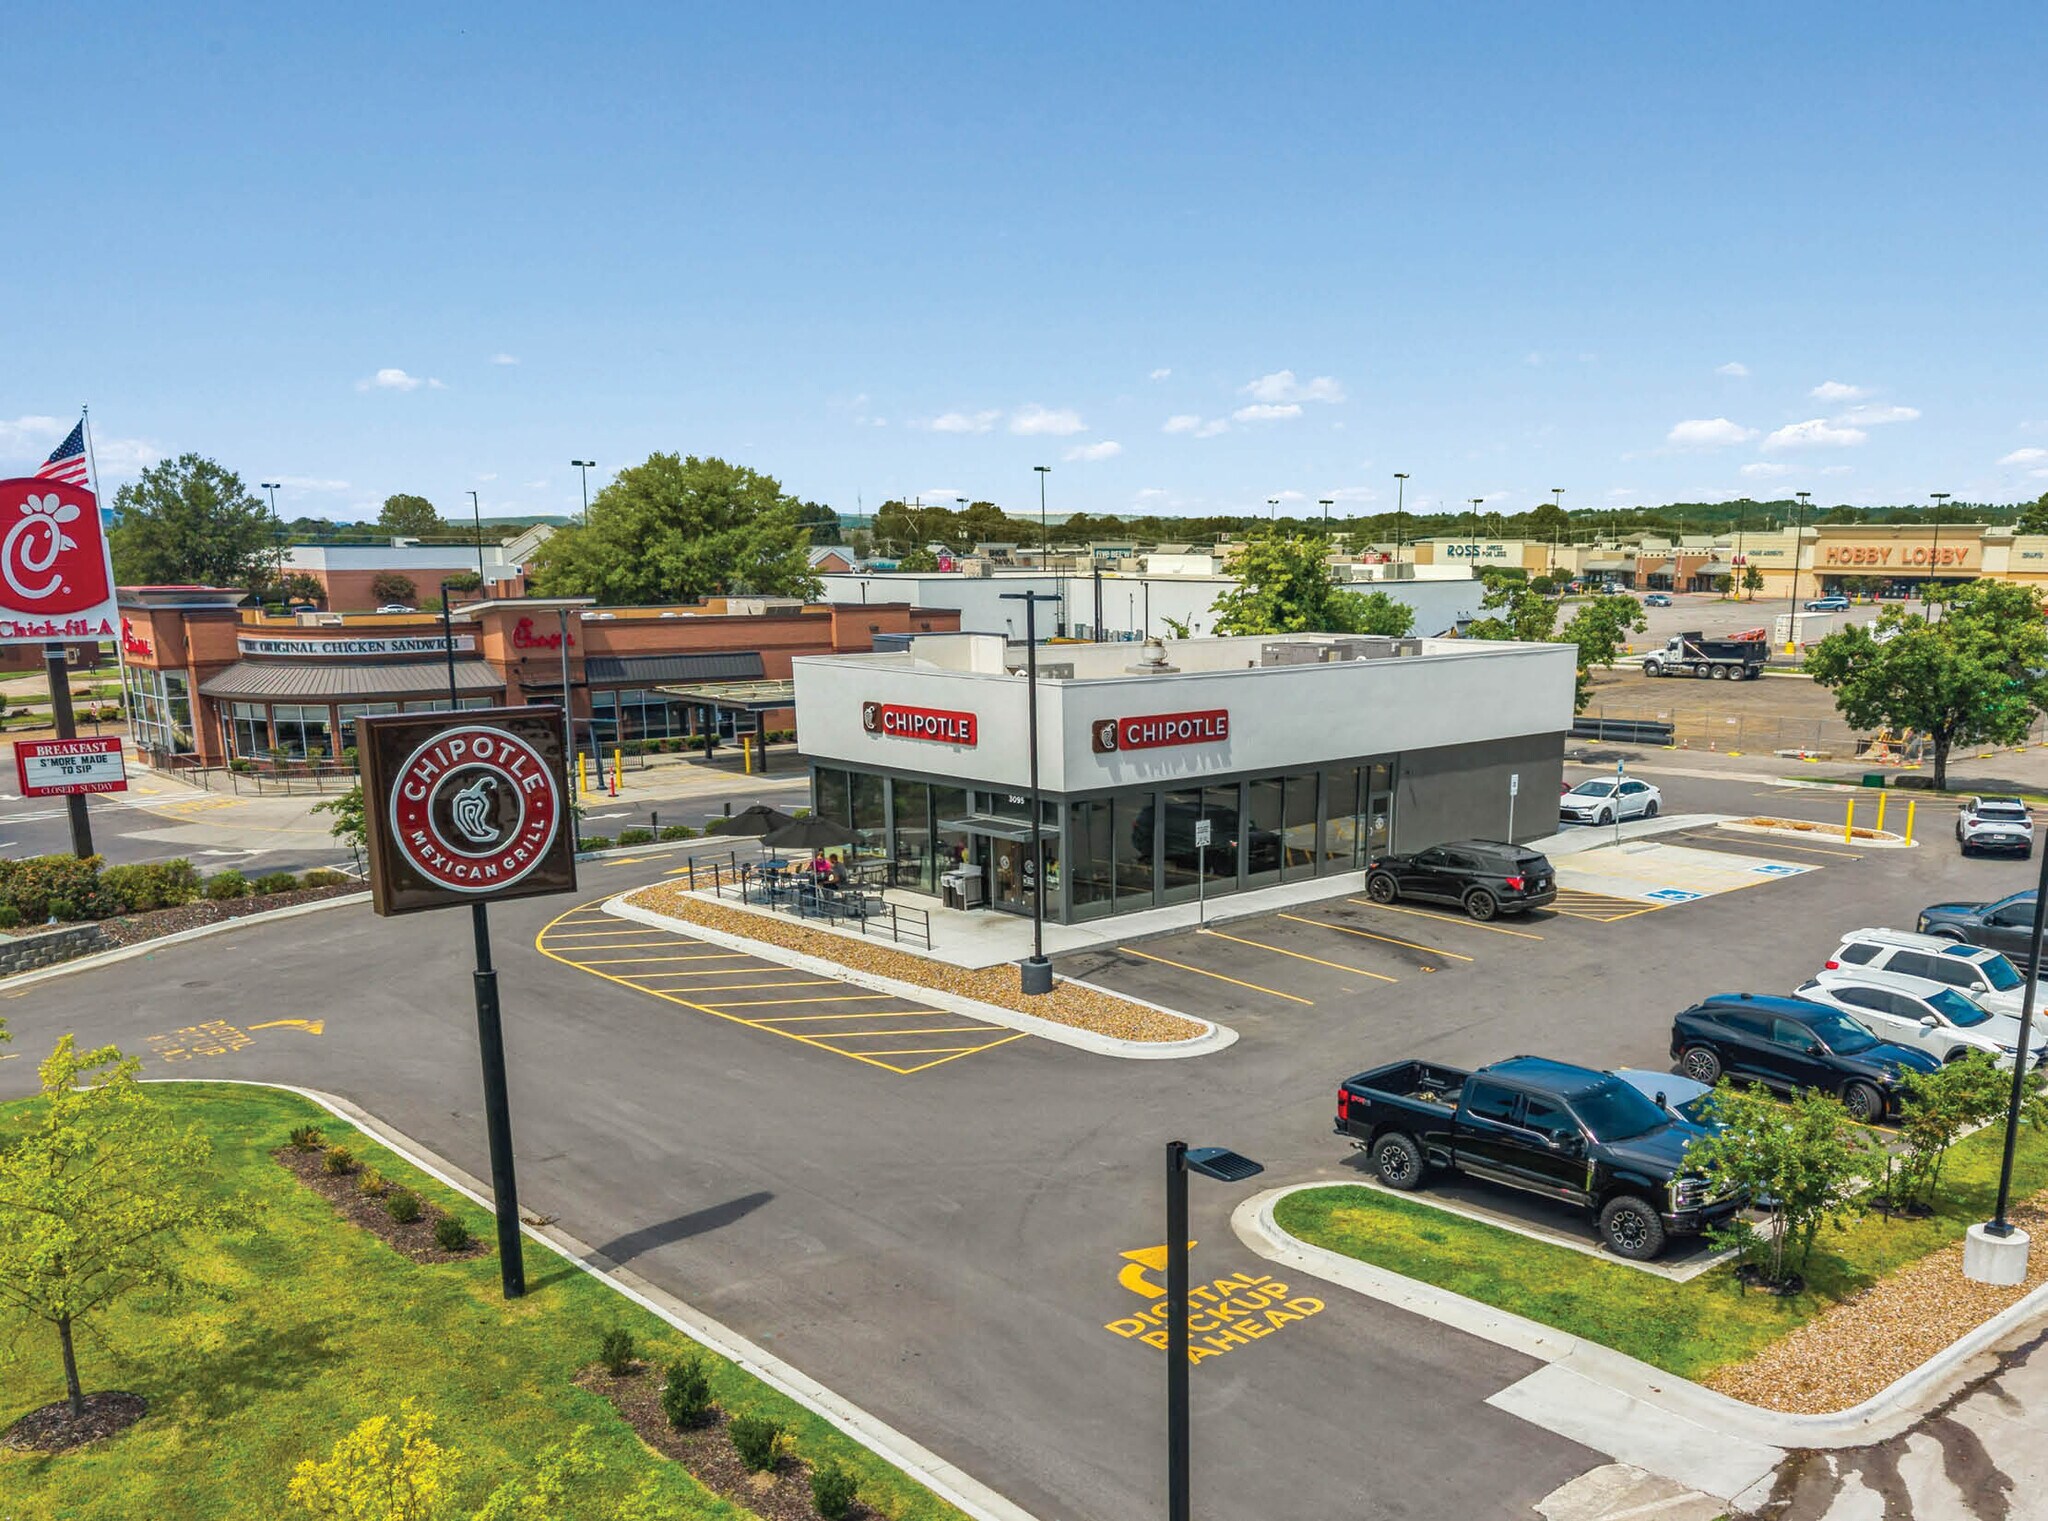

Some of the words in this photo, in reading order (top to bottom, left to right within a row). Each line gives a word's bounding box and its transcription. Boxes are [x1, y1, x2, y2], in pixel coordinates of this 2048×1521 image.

[1447, 544, 1480, 557] ROSS
[1825, 546, 1892, 565] HOBBY
[1900, 546, 1968, 565] LOBBY
[0, 618, 115, 638] Chick-fil-A
[260, 640, 317, 653] ORIGINAL
[323, 641, 386, 653] CHICKEN
[391, 639, 459, 651] SANDWICH
[884, 711, 970, 739] CHIPOTLE
[1127, 716, 1227, 743] CHIPOTLE
[36, 742, 107, 756] BREAKFAST
[40, 757, 76, 768] S'MORE
[81, 755, 107, 765] MADE
[61, 766, 73, 775] TO
[76, 765, 92, 774] SIP
[404, 737, 545, 801] CHIPOTLE
[41, 785, 75, 795] CLOSED
[80, 783, 113, 792] SUNDAY
[1008, 795, 1024, 805] 3095
[411, 830, 497, 879] MEXICAN
[502, 820, 545, 870] GRILL
[1139, 1282, 1289, 1350] PCKUP
[1188, 1297, 1326, 1365] AHEAD
